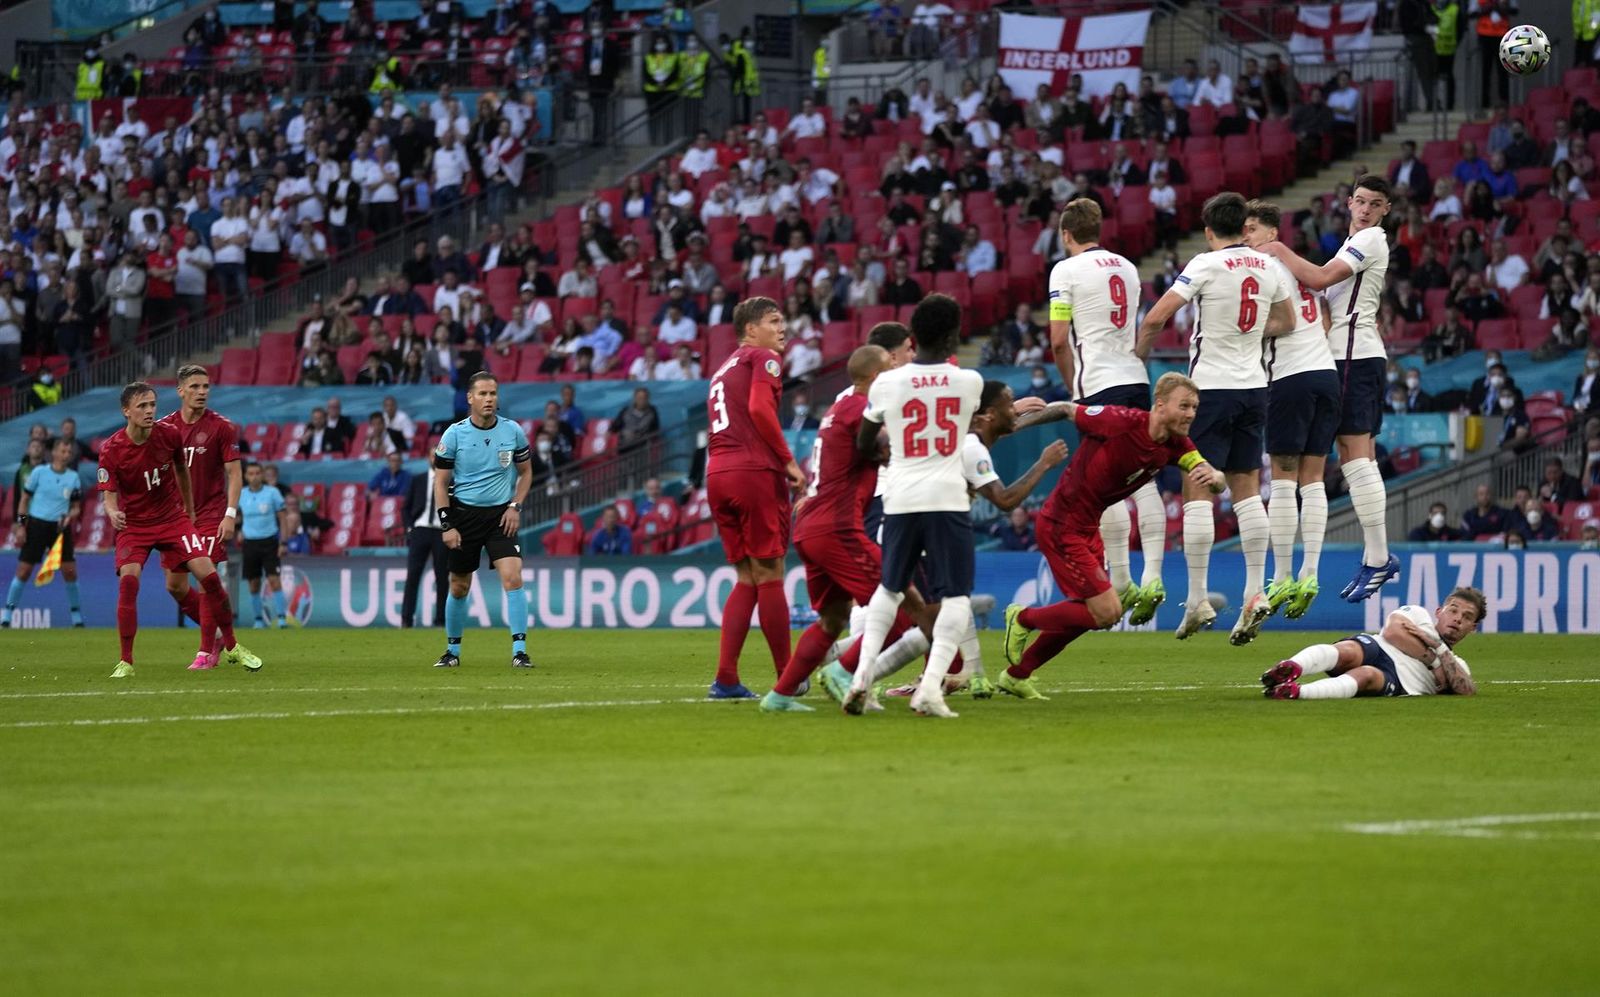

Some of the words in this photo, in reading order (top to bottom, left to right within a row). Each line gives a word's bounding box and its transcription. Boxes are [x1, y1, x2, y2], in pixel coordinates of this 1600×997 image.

[1003, 48, 1131, 70] INGERLUND
[1109, 274, 1128, 329] 9
[1238, 276, 1260, 333] 6
[911, 375, 949, 389] SAKA
[709, 381, 730, 433] 3
[902, 397, 961, 458] 25
[144, 468, 161, 491] 14
[182, 534, 203, 554] 14
